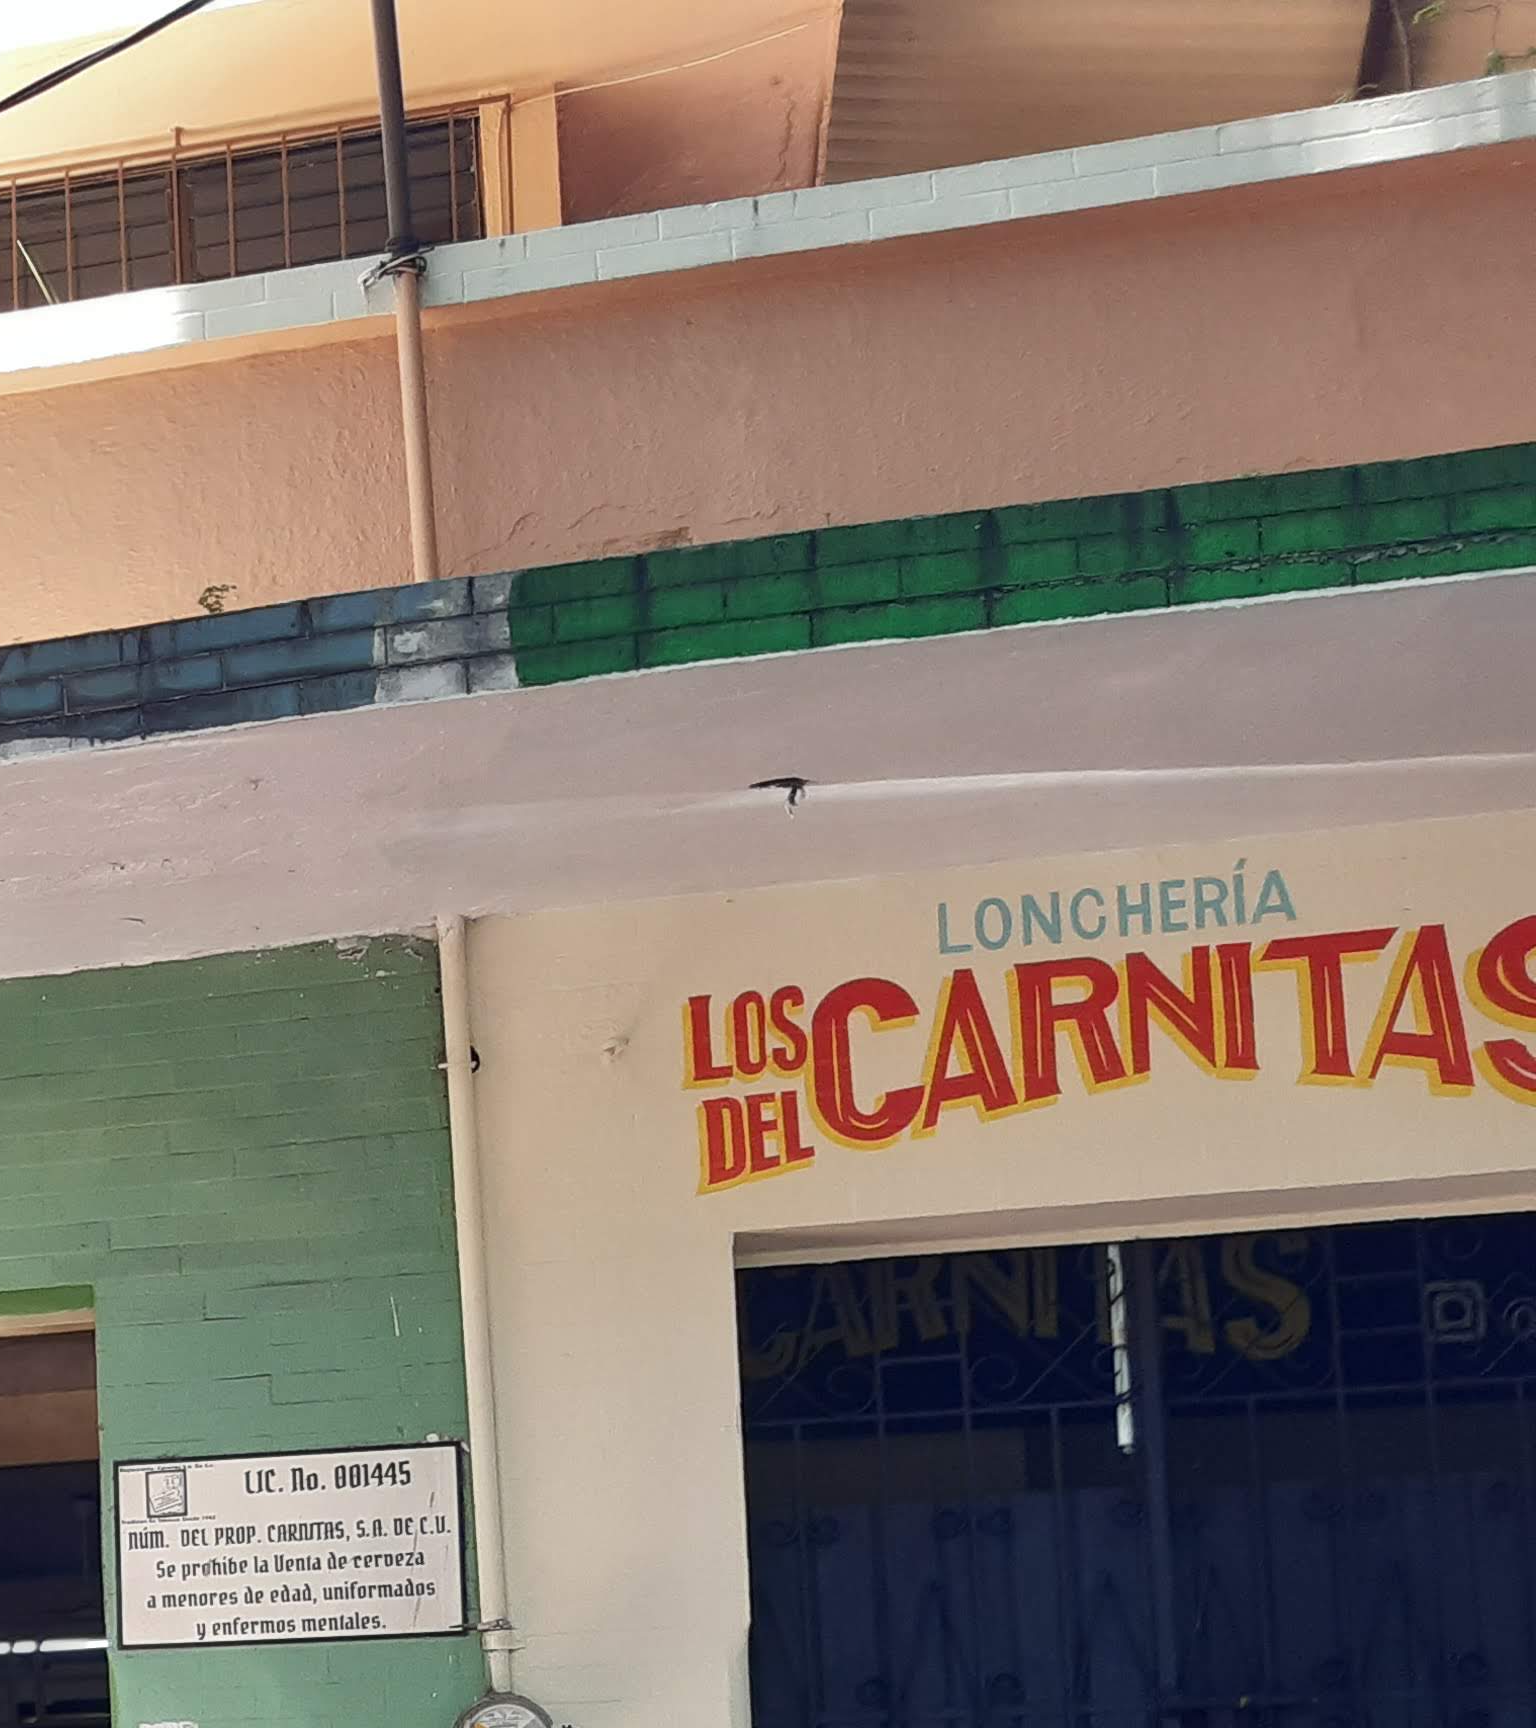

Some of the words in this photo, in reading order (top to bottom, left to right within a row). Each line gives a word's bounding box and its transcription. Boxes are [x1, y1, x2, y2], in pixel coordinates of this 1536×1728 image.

[938, 858, 1297, 955] LONCHERÍA
[682, 985, 809, 1089] LOS
[804, 915, 1536, 1152] CARNITAS
[696, 1090, 816, 1196] DEL
[291, 1467, 326, 1493] No.
[334, 1460, 411, 1489] 001445
[181, 1528, 209, 1547] DEL
[215, 1525, 262, 1546] PROP.
[267, 1521, 350, 1543] CARNITAS,
[356, 1518, 388, 1538] S.A.
[394, 1517, 415, 1536] DE
[156, 1560, 176, 1579] Se
[254, 1556, 269, 1574] la
[273, 1554, 322, 1573] Venta
[327, 1552, 348, 1570] de
[353, 1551, 425, 1569] cerveza
[147, 1594, 156, 1609] a
[162, 1591, 238, 1609] menores
[244, 1586, 264, 1604] de
[270, 1583, 318, 1605] edad,
[323, 1578, 436, 1601] uniformados
[196, 1622, 206, 1641] y
[212, 1617, 296, 1636] enfermos
[302, 1612, 387, 1633] mentales.
